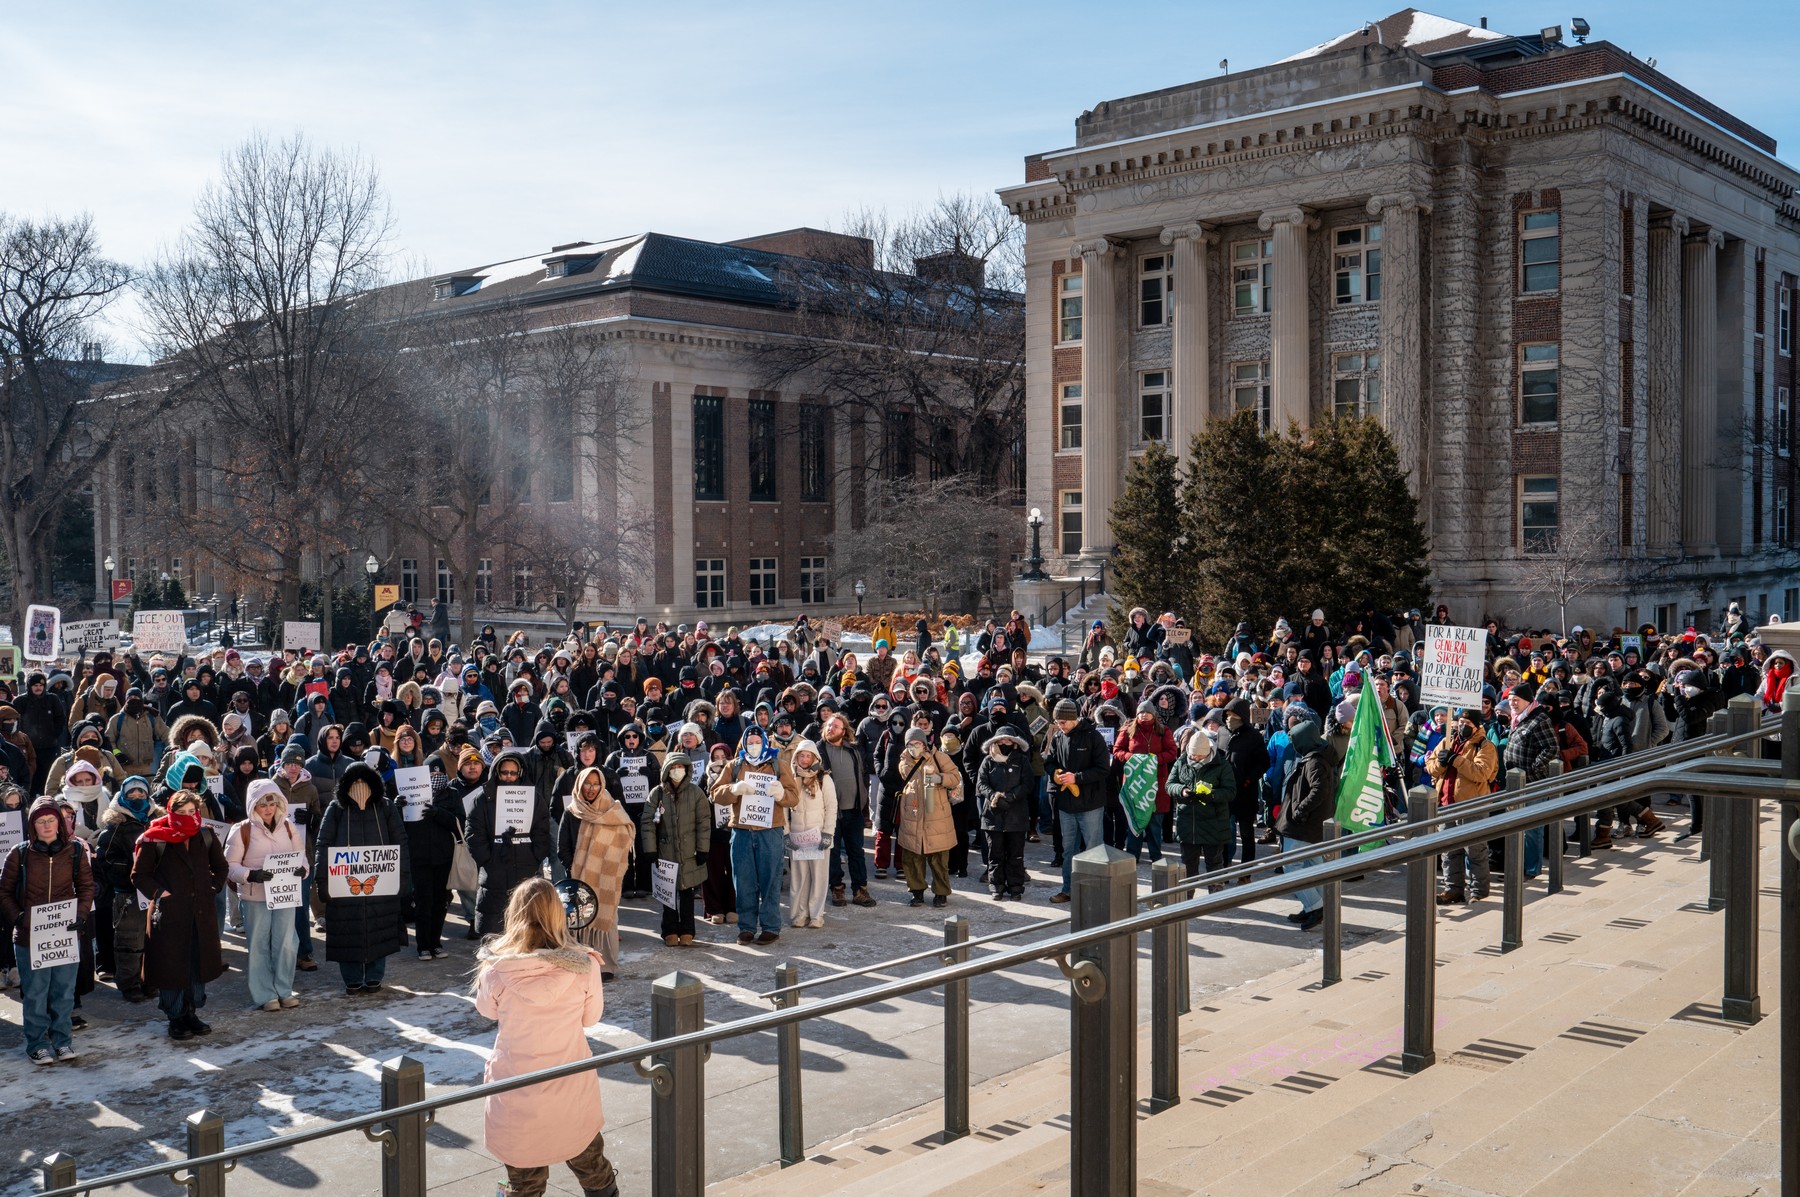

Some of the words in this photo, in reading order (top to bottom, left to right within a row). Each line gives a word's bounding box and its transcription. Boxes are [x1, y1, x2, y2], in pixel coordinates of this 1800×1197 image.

[1429, 626, 1444, 638] FOR
[1447, 627, 1451, 638] A
[1455, 628, 1479, 641] REAL
[1435, 639, 1469, 654] GENERAL
[1436, 652, 1465, 666] STRIKE
[1425, 662, 1433, 673] TO
[1436, 664, 1461, 677] DRIVE
[1464, 668, 1480, 680] OUT
[1424, 676, 1442, 687] ICE
[1445, 678, 1481, 693] GESTAPO
[749, 774, 773, 782] PROTECT
[747, 814, 766, 822] NOW!
[334, 851, 360, 864] MN
[363, 849, 399, 862] STANDS
[329, 864, 349, 876] WITH
[350, 863, 395, 875] IMMIGRANTS
[270, 885, 281, 893] ICE
[273, 894, 294, 903] NOW!
[37, 902, 72, 914] PROTECT
[34, 919, 73, 932] STUDENTS
[37, 941, 51, 951] ICE
[54, 938, 72, 947] OUT
[41, 950, 69, 960] NOW!
